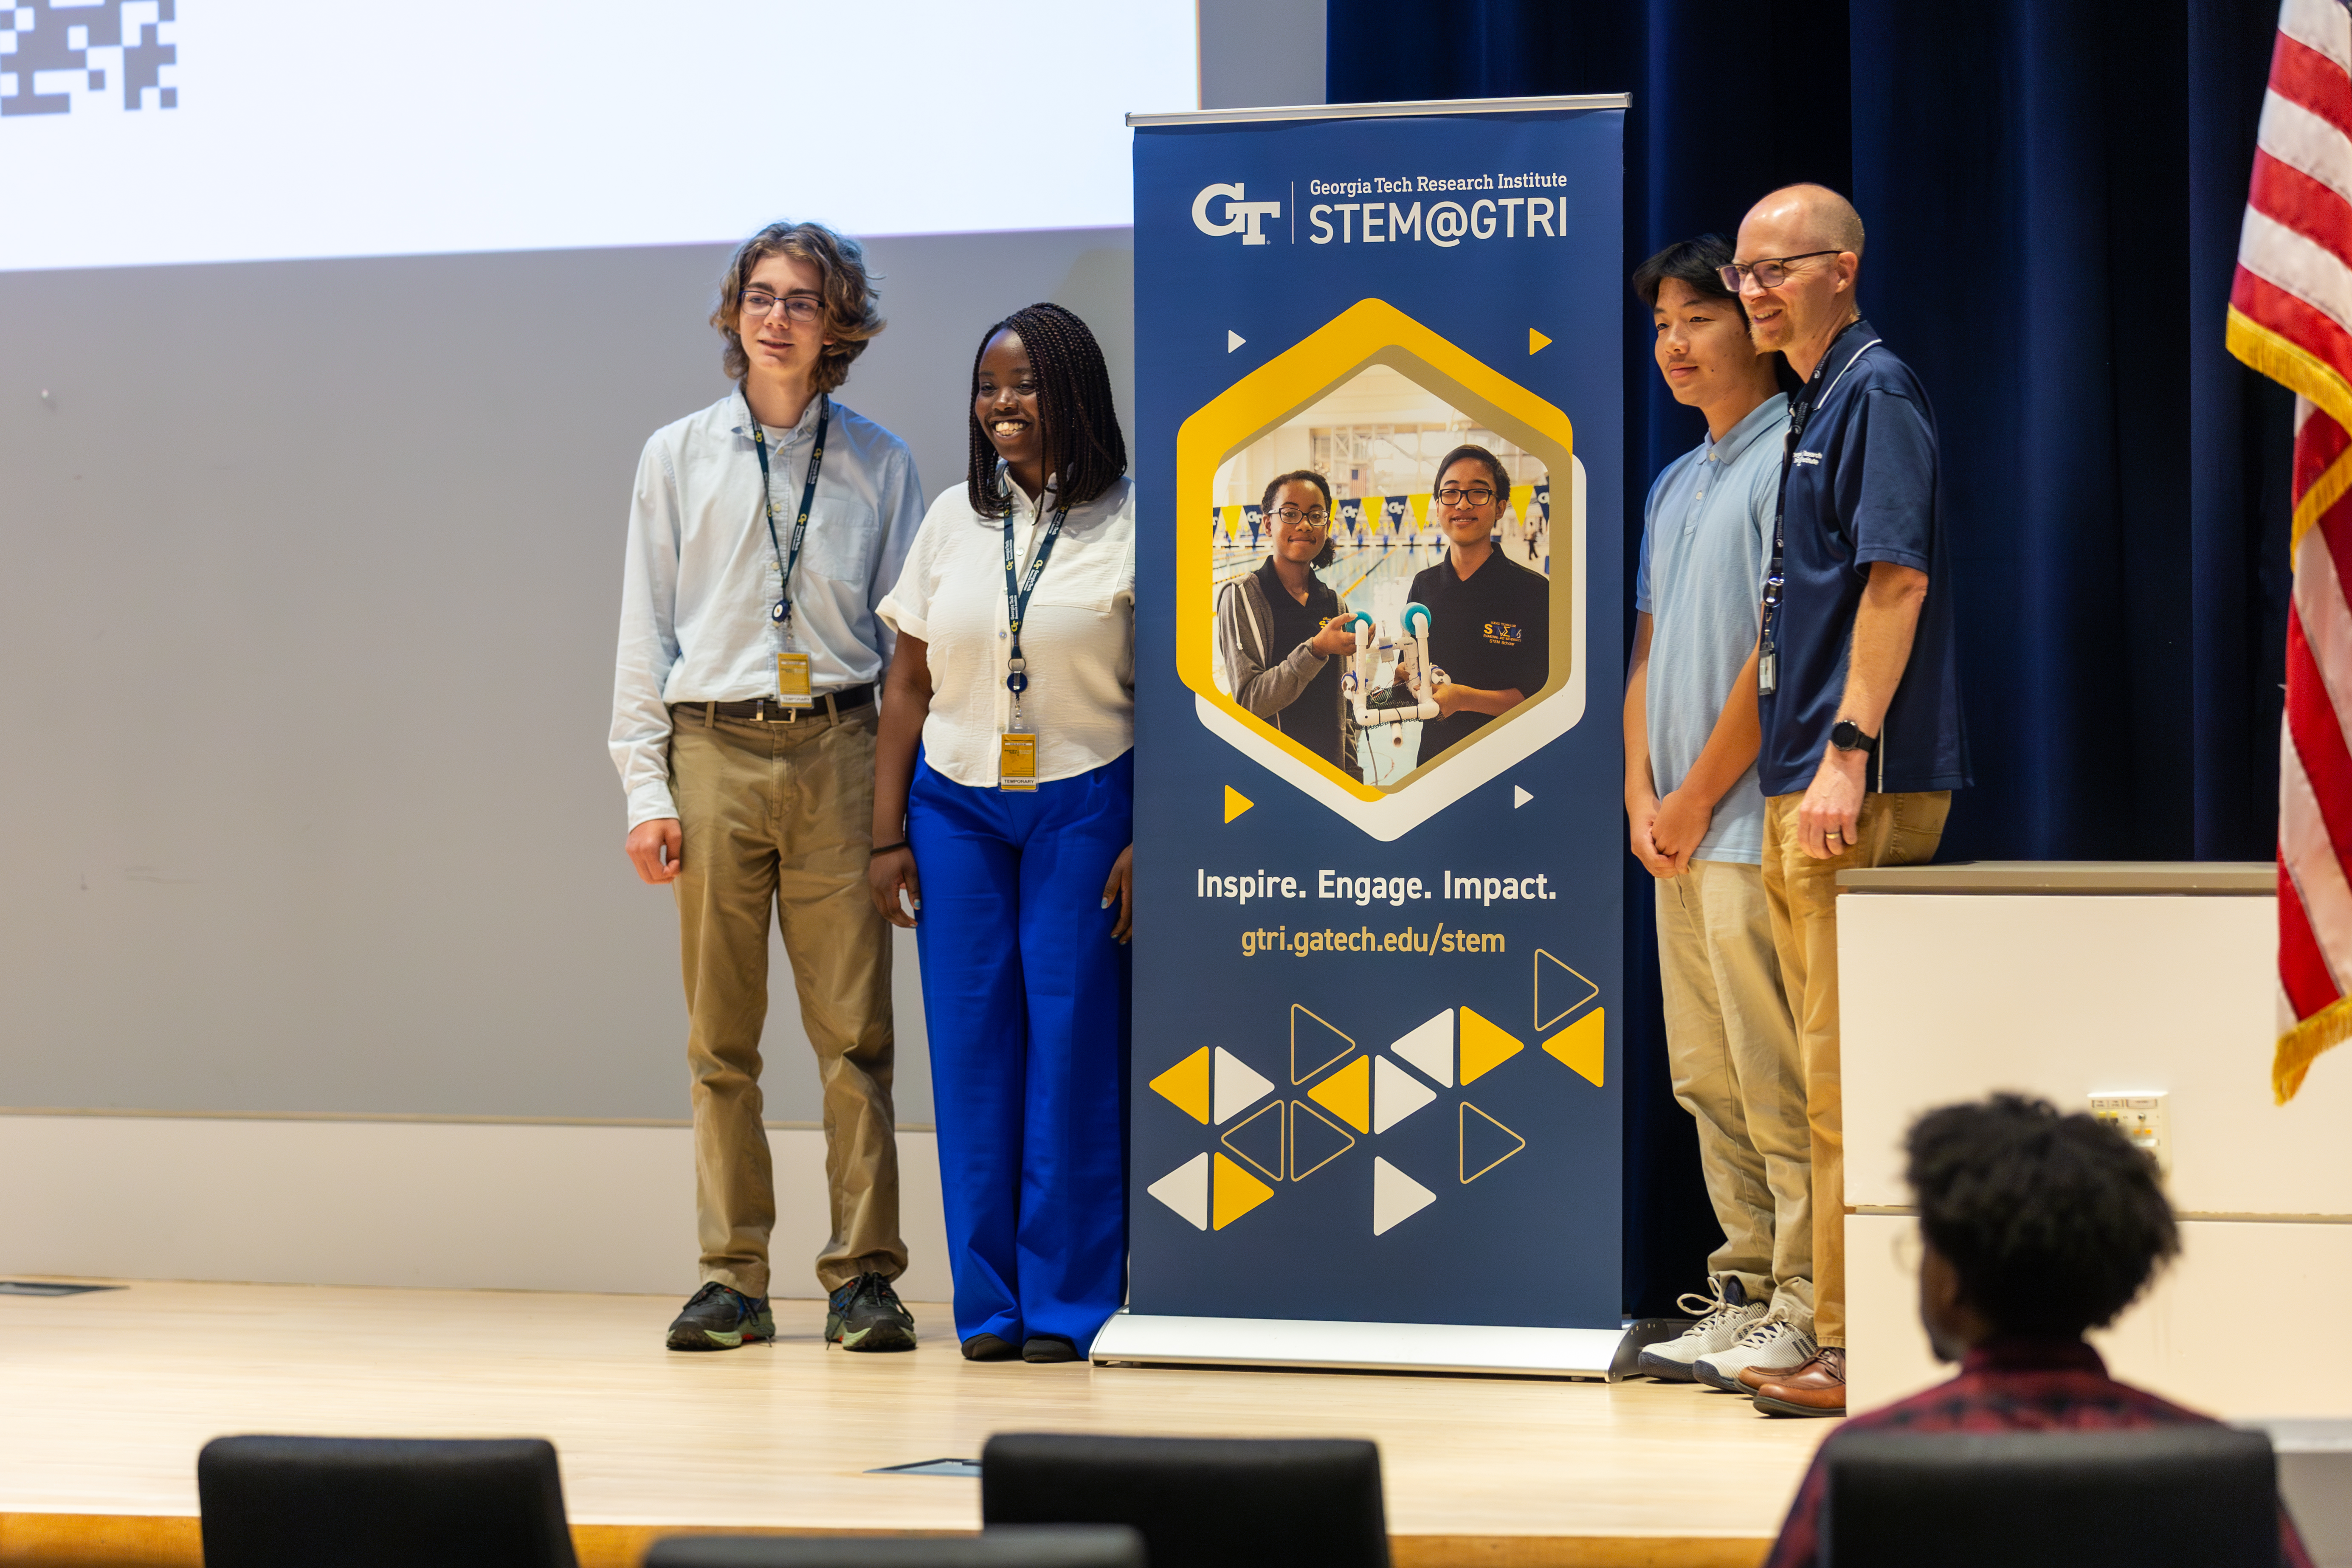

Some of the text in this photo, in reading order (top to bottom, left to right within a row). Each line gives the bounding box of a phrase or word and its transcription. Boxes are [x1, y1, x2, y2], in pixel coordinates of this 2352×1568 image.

[1310, 172, 1567, 198] Georgia Tech Research Institute
[1191, 183, 1280, 245] GT
[1310, 194, 1566, 247] STEM@GTRI
[1538, 492, 1549, 505] G
[1342, 506, 1358, 518] GT
[1388, 501, 1405, 515] GT
[1006, 560, 1014, 570] GT
[1034, 559, 1043, 569] GT
[1011, 620, 1019, 632] GT
[1198, 869, 1556, 906] Inspire. Engage. Impact.
[1242, 922, 1505, 957] gtri.gatech.edu/stem
